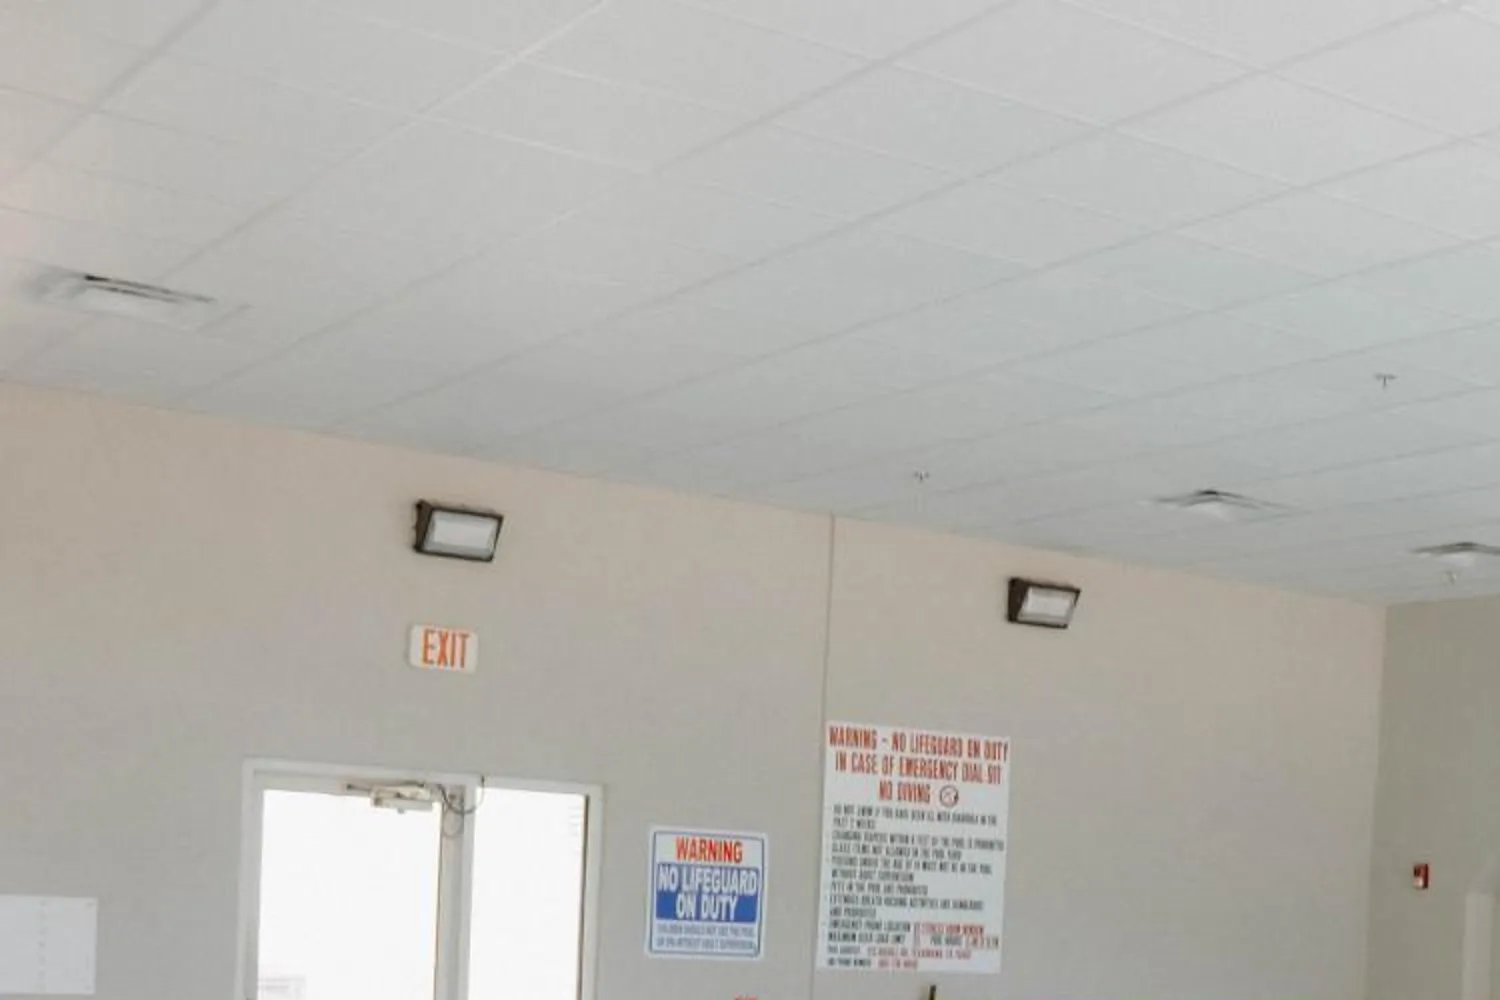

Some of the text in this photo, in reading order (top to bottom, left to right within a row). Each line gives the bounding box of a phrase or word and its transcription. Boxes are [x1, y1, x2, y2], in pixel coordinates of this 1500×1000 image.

[423, 627, 470, 669] EXIT
[828, 725, 878, 750] WARNING
[891, 731, 907, 752] NO
[909, 732, 963, 758] LIFEGUARD
[983, 738, 1009, 762] DUTY
[835, 751, 847, 773] IN
[851, 752, 878, 775] CASE
[881, 754, 895, 777] OF
[899, 756, 959, 781] EMERGENCY
[879, 779, 931, 804] NO DIVING
[675, 836, 743, 864] WARNING
[658, 865, 757, 896] NO LIFEGUARD
[676, 892, 738, 922] ON DUTY
